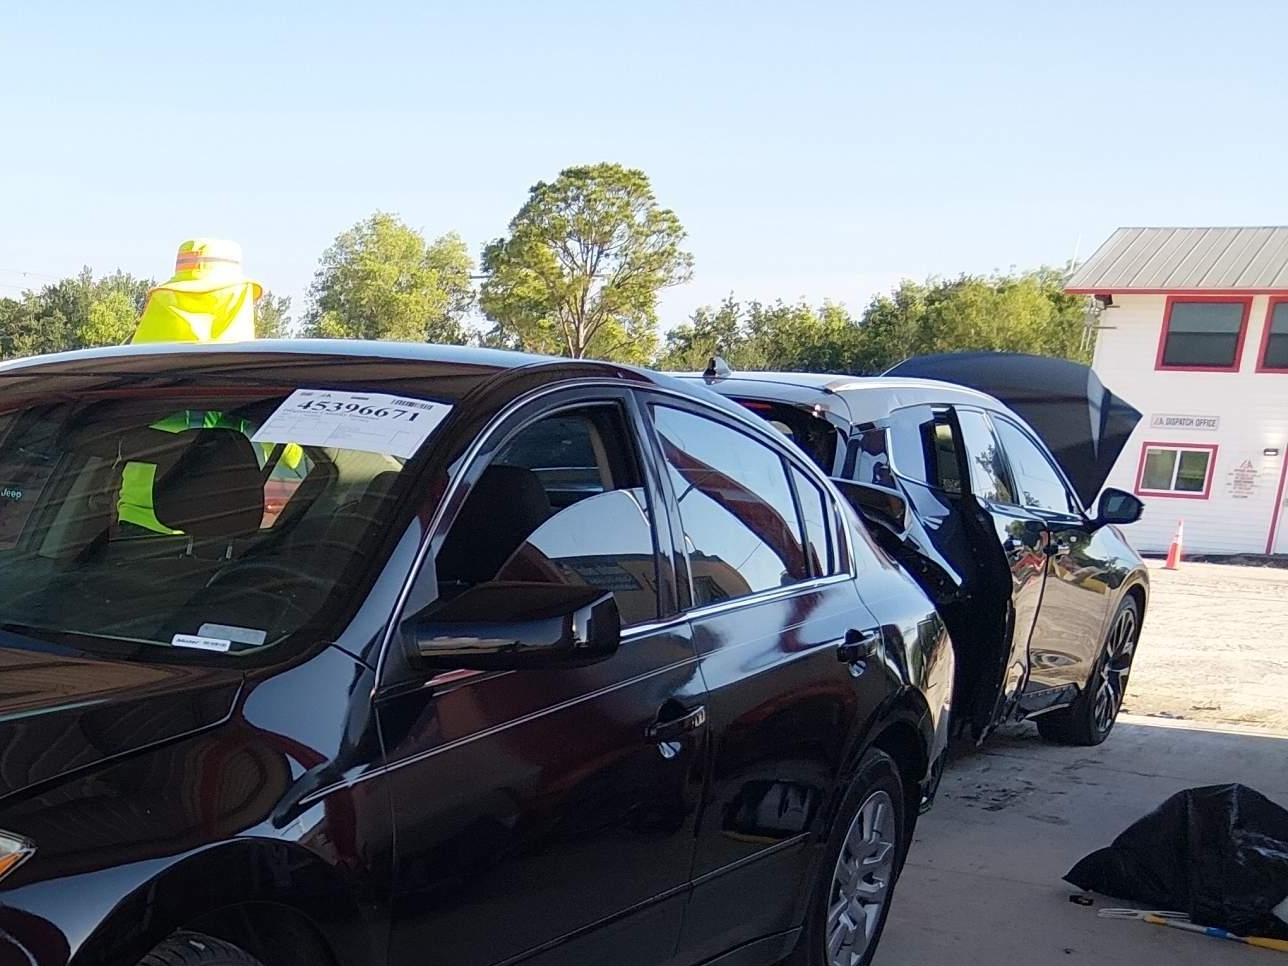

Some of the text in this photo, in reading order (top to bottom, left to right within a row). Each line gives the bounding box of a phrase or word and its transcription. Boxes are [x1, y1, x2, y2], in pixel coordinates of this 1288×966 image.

[297, 400, 420, 422] 45396671
[1165, 417, 1194, 427] DISPATCH
[1195, 418, 1217, 428] OFFICE
[1, 488, 22, 501] Jeep
